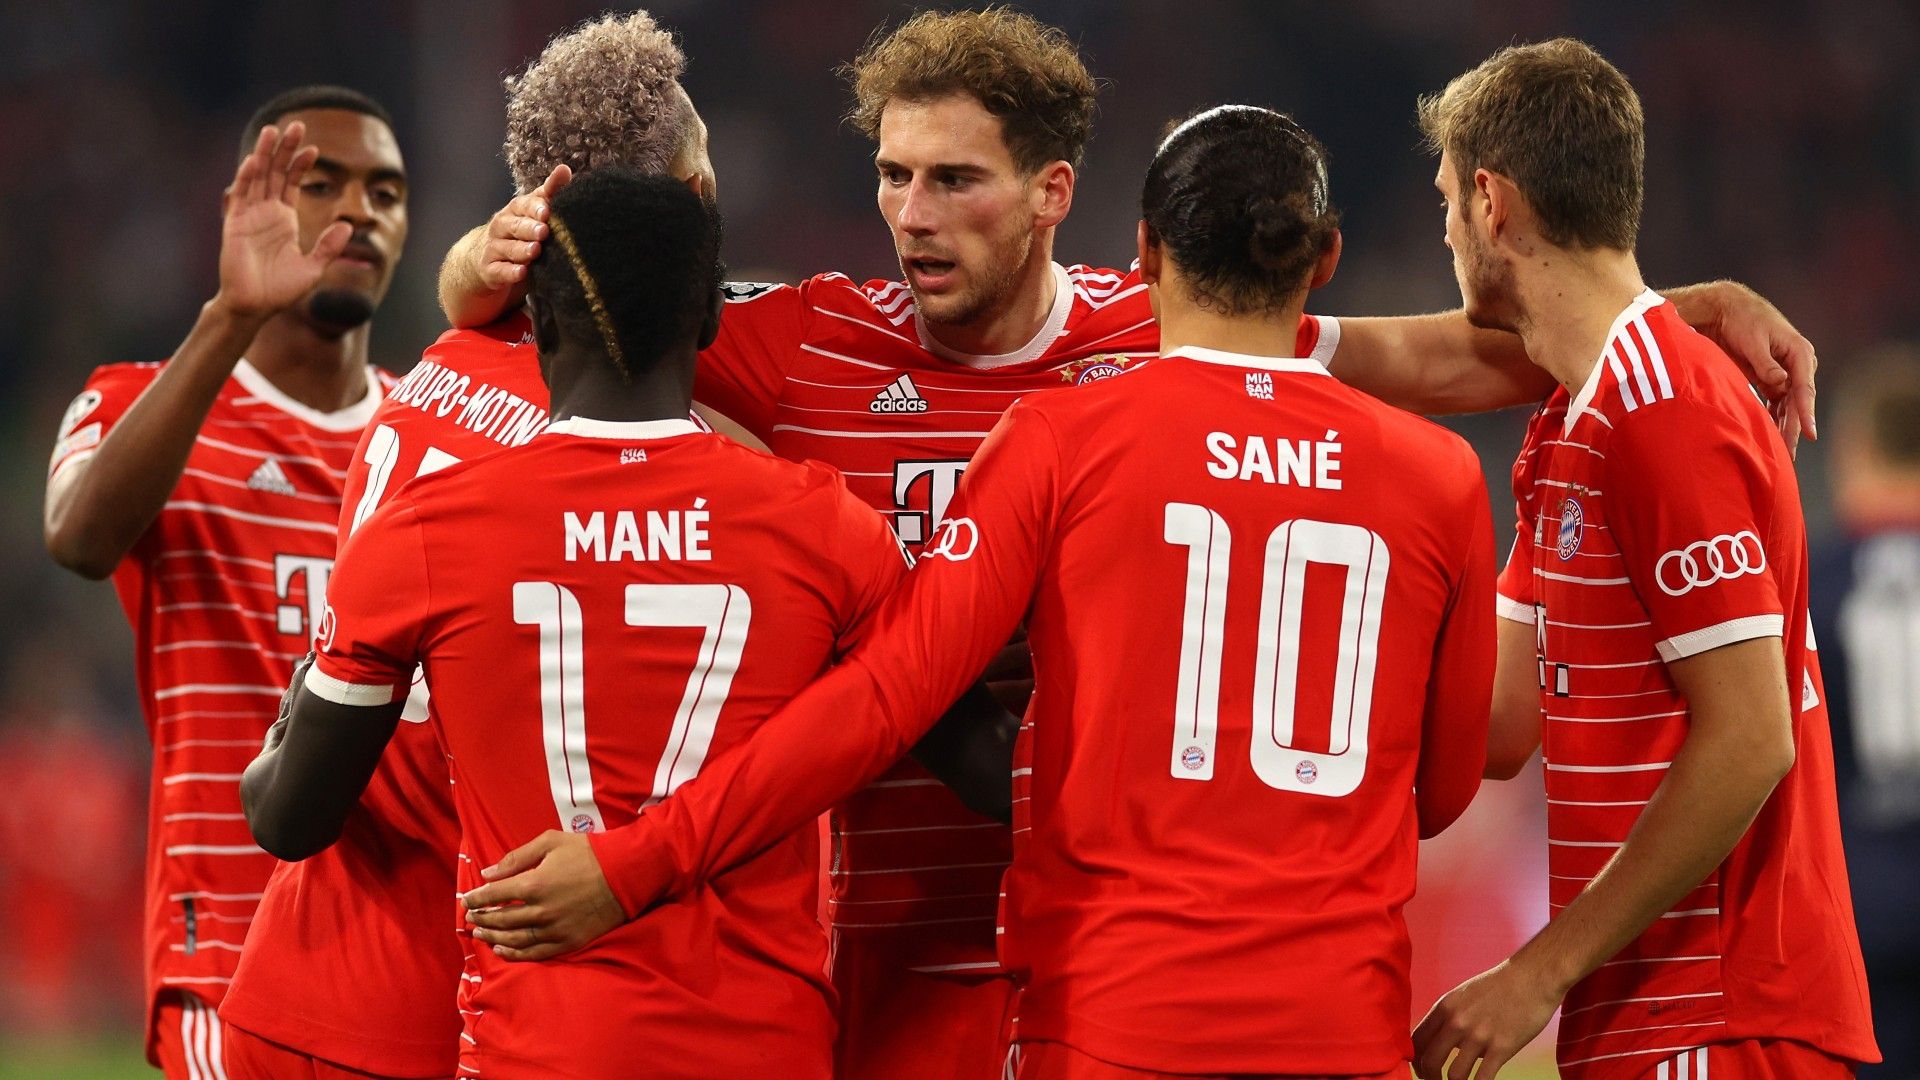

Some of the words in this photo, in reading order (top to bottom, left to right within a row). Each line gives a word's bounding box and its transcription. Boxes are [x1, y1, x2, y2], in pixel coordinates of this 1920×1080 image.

[1245, 372, 1273, 384] MIA
[1245, 383, 1274, 394] SAN
[869, 397, 928, 412] adidas
[621, 448, 647, 457] MIA
[1206, 430, 1343, 490] SANÉ
[564, 497, 713, 562] MANÉ
[1164, 502, 1391, 797] 10
[512, 581, 752, 834] 17
